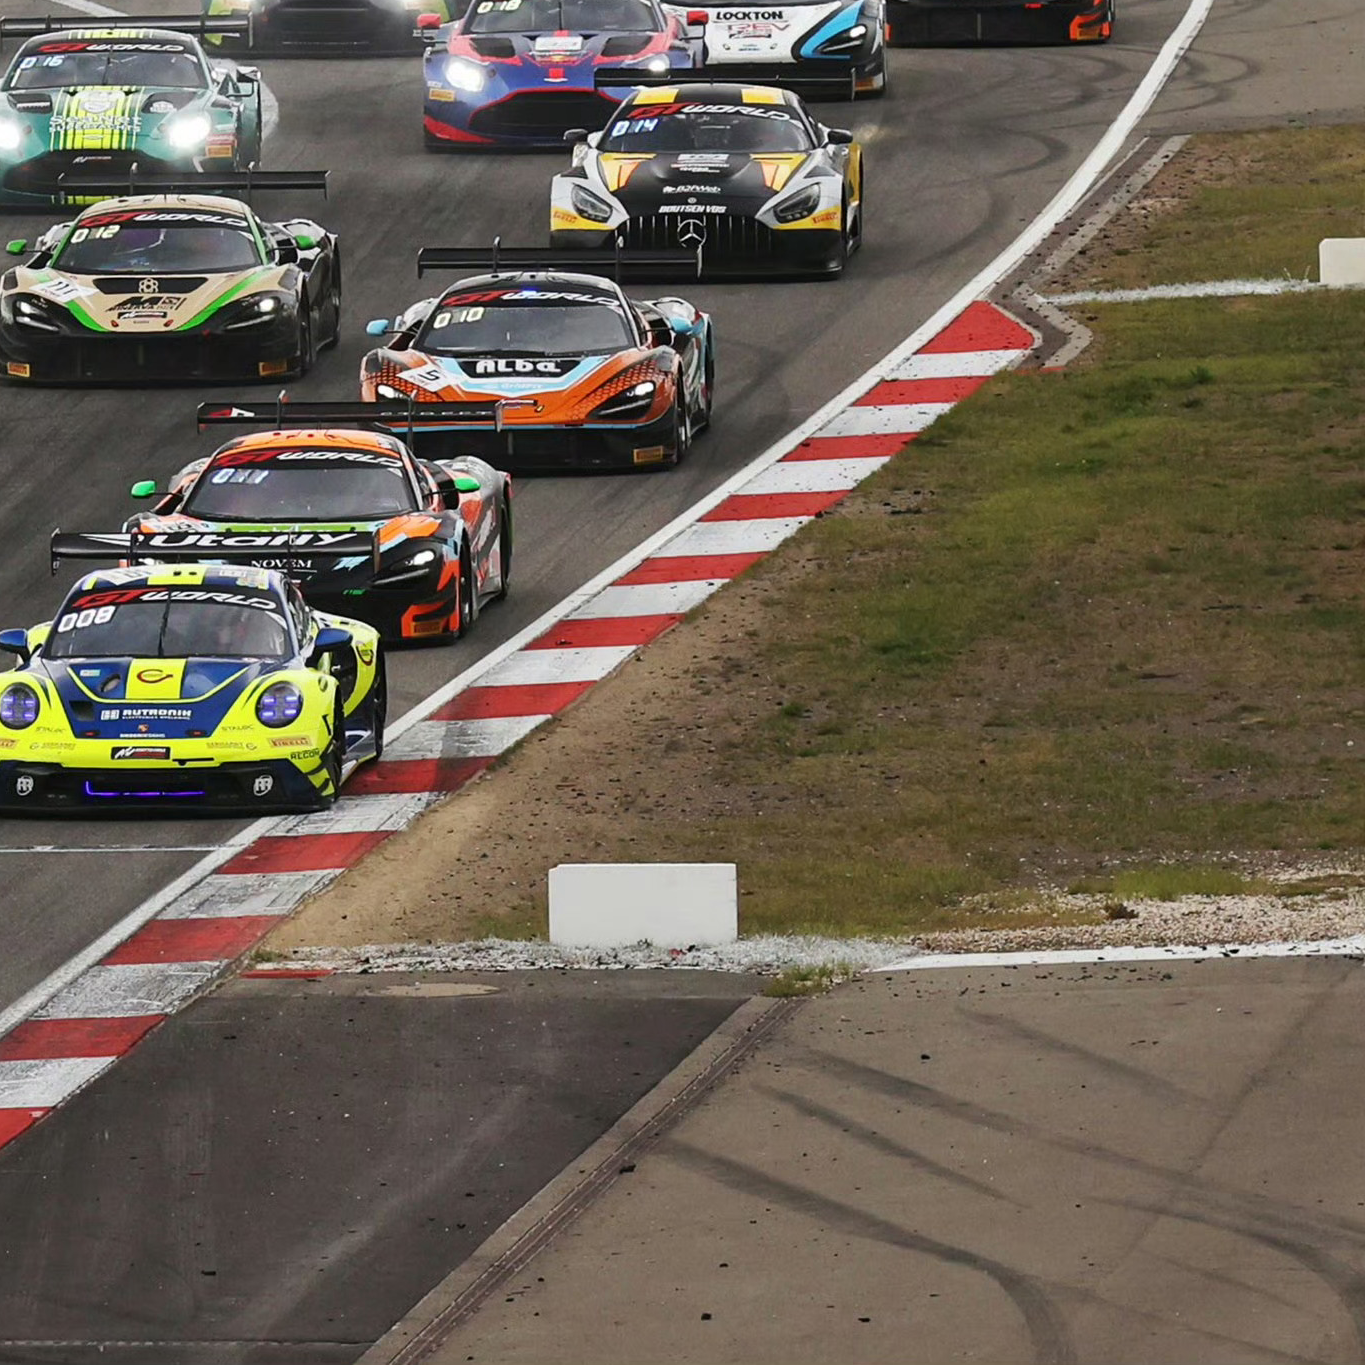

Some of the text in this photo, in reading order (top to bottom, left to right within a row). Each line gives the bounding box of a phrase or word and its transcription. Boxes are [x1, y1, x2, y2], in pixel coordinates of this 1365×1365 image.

[715, 10, 784, 21] LOCKTON
[683, 104, 792, 121] WORLD
[132, 212, 249, 228] WORLD
[501, 290, 620, 307] WORLD
[276, 450, 403, 468] WORLD
[139, 590, 278, 610] WORLD
[57, 605, 117, 633] 008
[121, 708, 193, 718] RUTRONIK
[270, 736, 312, 748] PIRELLI
